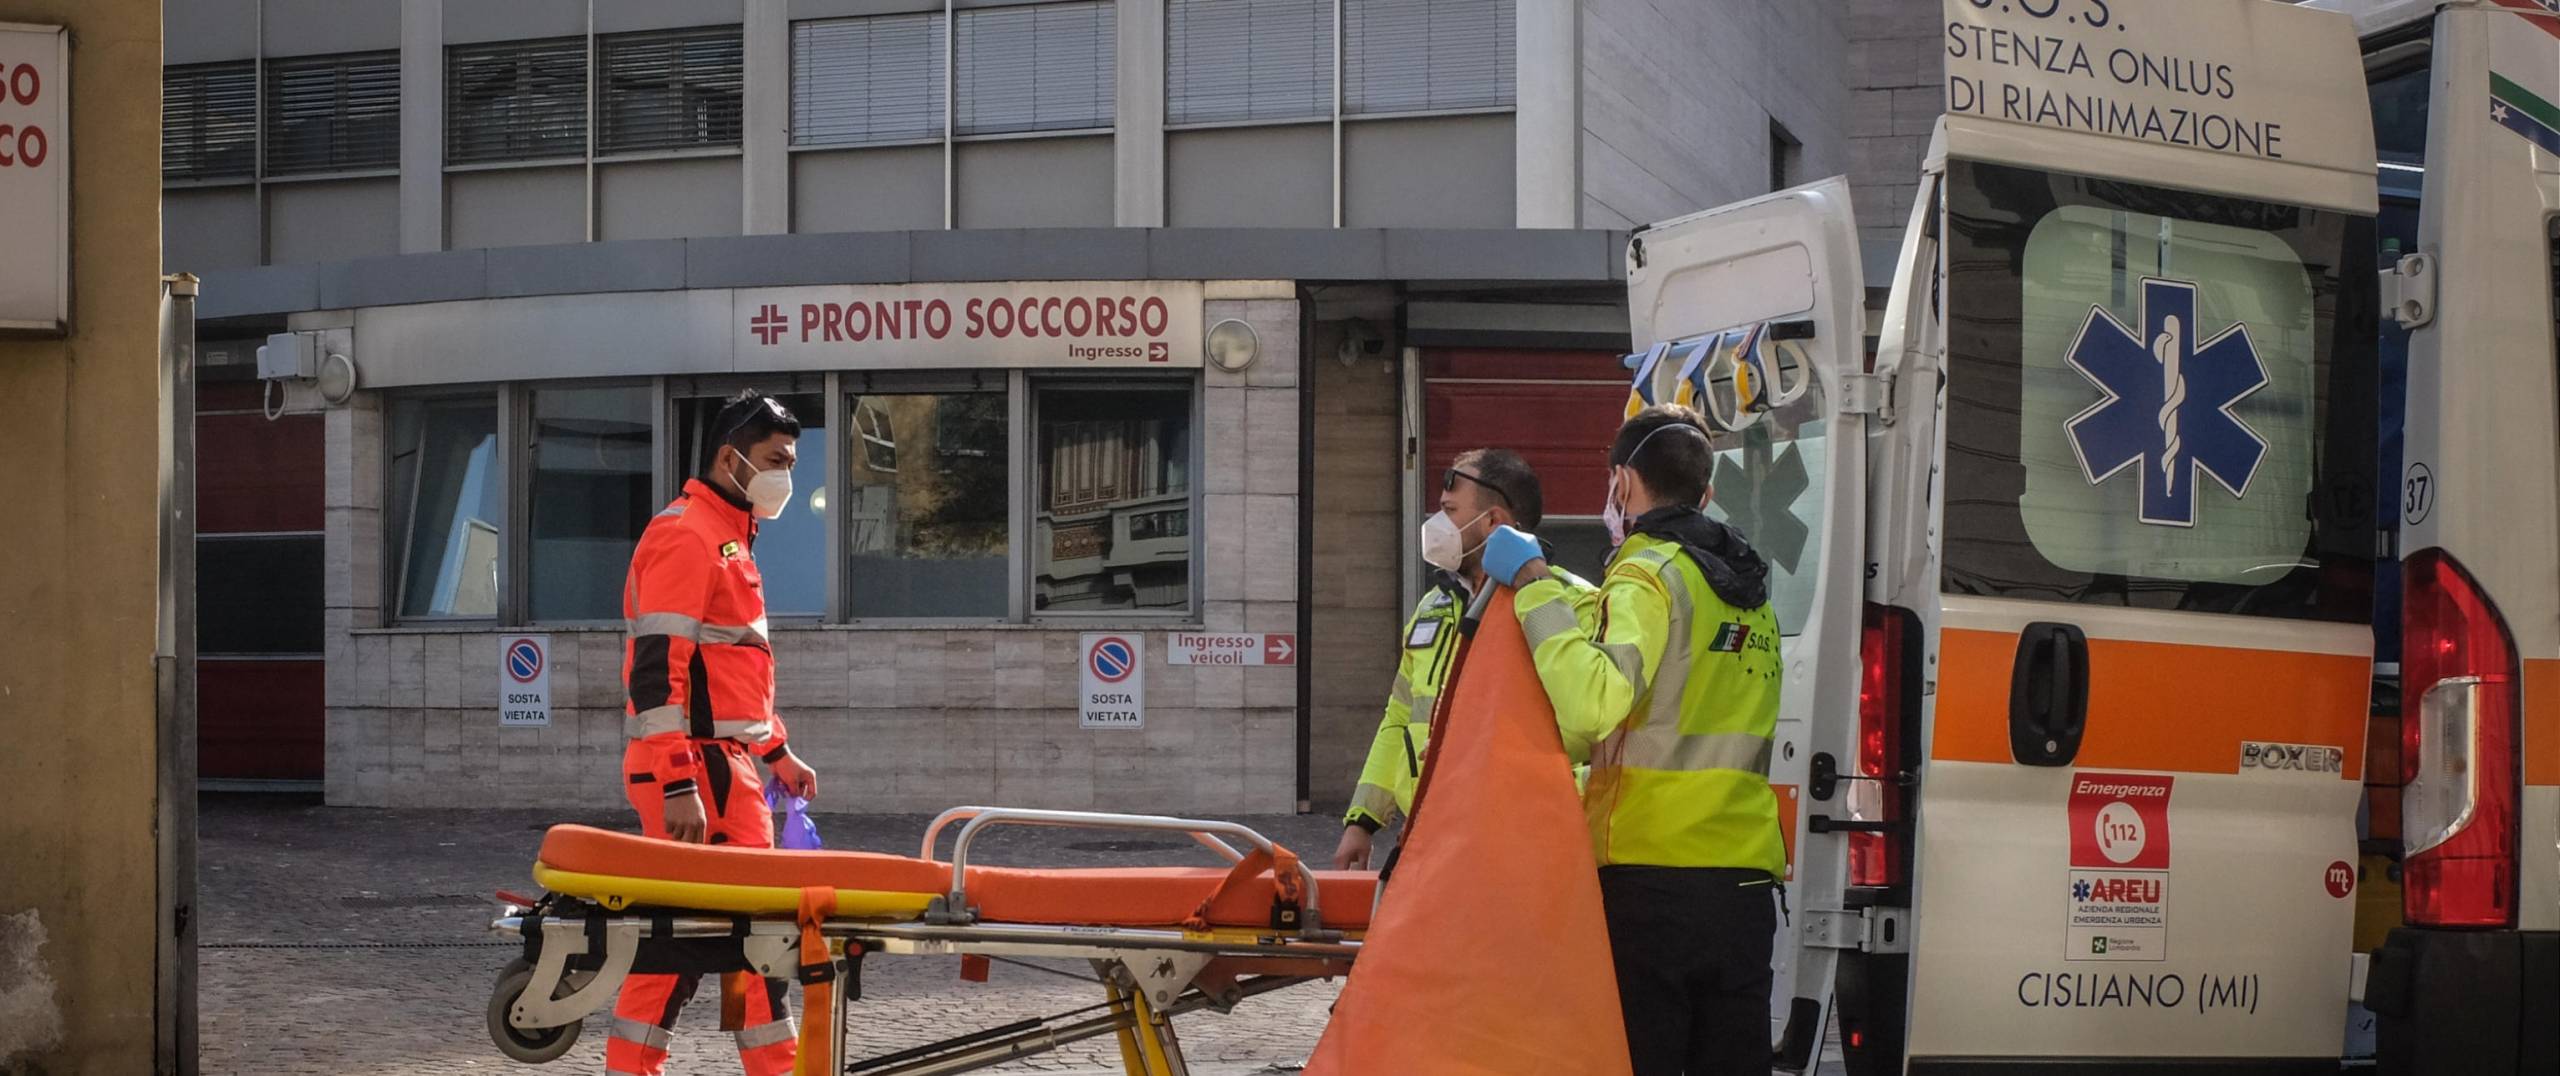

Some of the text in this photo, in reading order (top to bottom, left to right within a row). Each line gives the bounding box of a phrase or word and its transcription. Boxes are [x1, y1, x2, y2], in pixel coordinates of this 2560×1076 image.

[1947, 22, 2235, 99] STENZA ONLUS
[1950, 75, 2283, 158] DI RIANIMAZIONE
[801, 296, 1169, 343] PRONTO SOCCORSO
[1069, 343, 1143, 361] Ingresso
[2406, 475, 2428, 514] 37
[1177, 634, 1256, 651] Ingresso
[1189, 651, 1244, 665] veicoli
[508, 693, 541, 704] SOSTA
[1091, 693, 1133, 705] SOSTA
[504, 710, 546, 721] VIETATA
[1086, 711, 1138, 722] VIETATA
[2241, 742, 2343, 772] BOXER
[2076, 780, 2167, 798] Emergenza
[2110, 823, 2137, 841] 112
[2090, 878, 2161, 903] AREU
[2078, 905, 2160, 914] AZIENDA REGIONALE
[2073, 915, 2162, 924] EMERGENZA URGENZA
[2018, 972, 2259, 1015] CISLIANO (MI)
